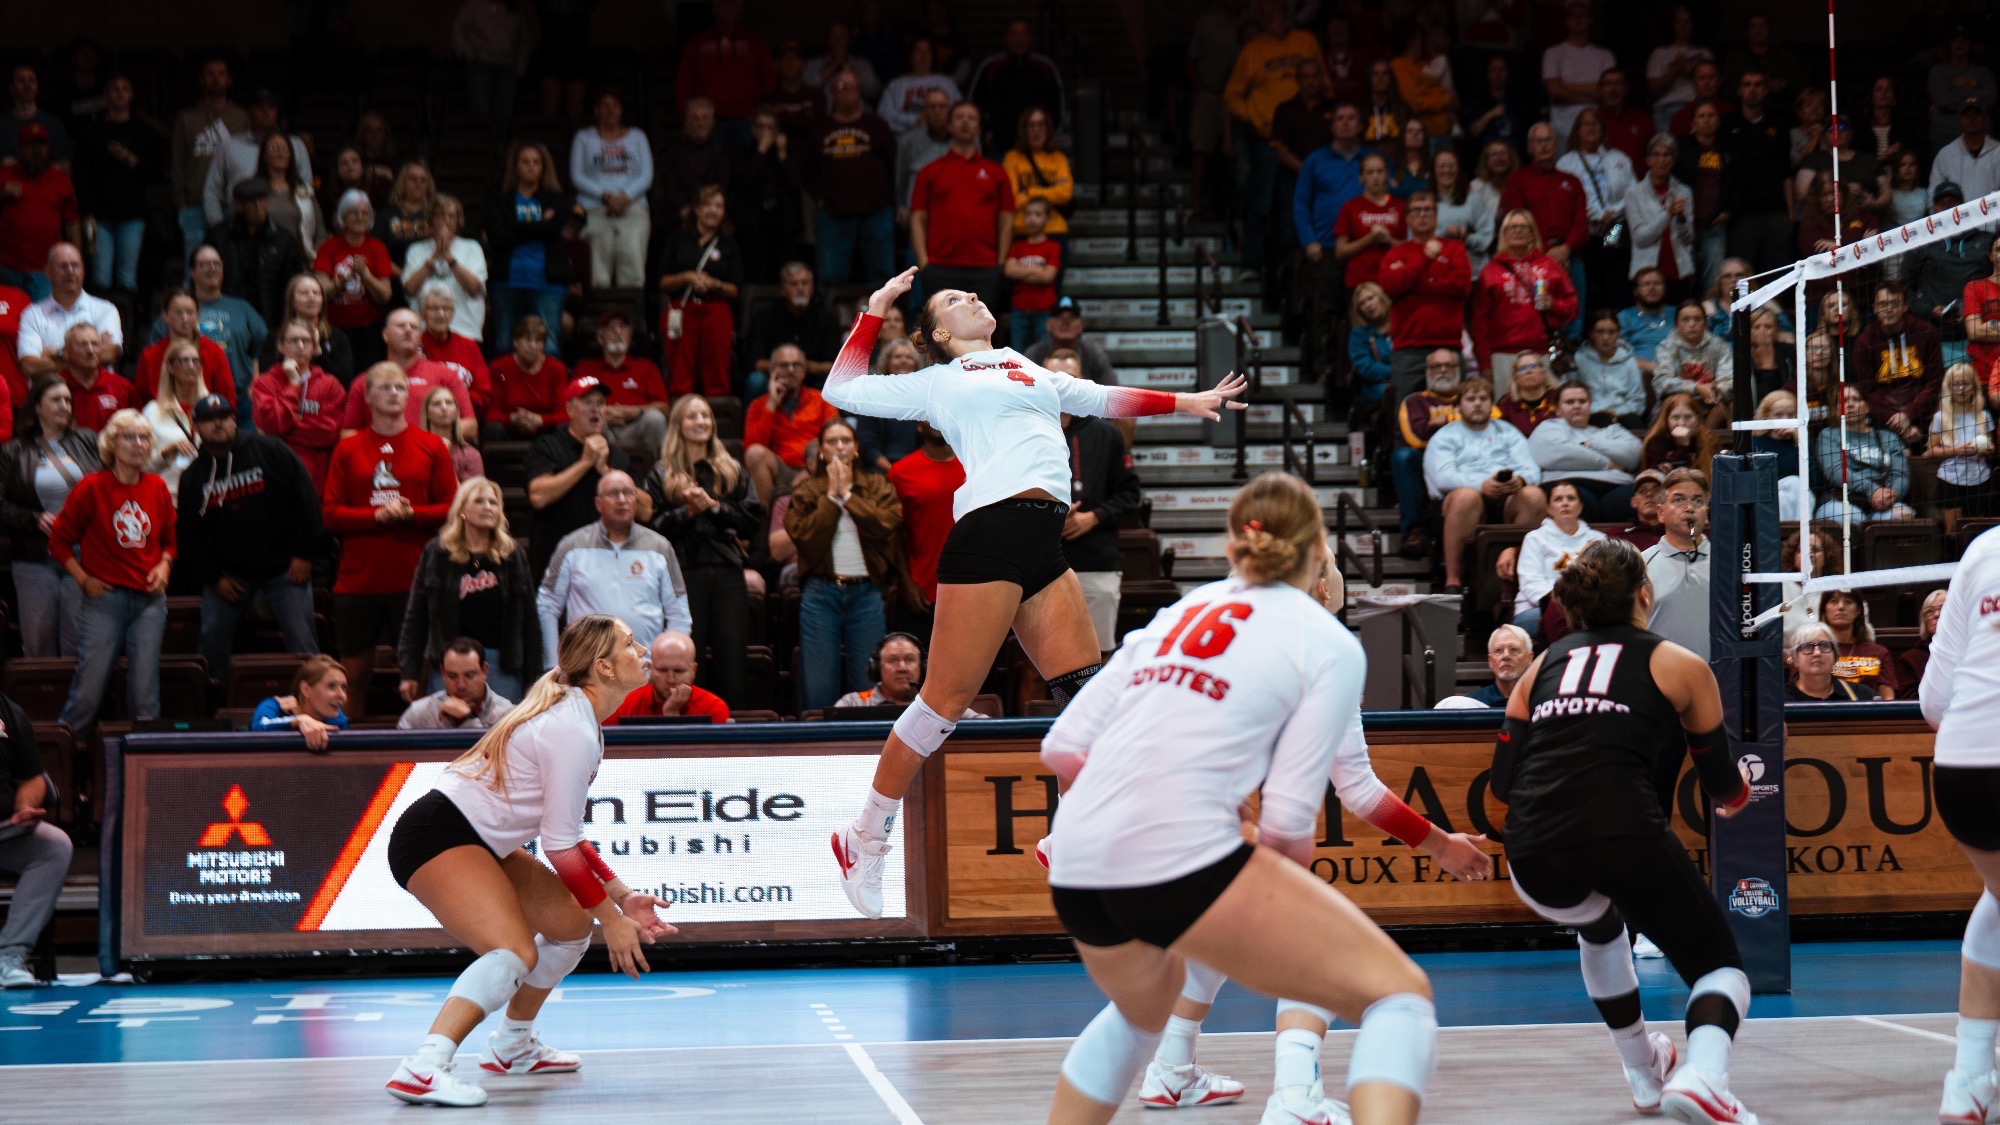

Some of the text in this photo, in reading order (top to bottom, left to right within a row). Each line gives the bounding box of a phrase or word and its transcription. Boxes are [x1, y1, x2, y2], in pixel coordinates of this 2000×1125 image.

[1154, 601, 1254, 660] 16
[1558, 642, 1625, 696] 11
[645, 788, 805, 823] Eide
[186, 850, 285, 868] MITSUBISHI
[199, 868, 272, 885] MOTORS
[1732, 896, 1776, 907] VOLLEYBALL
